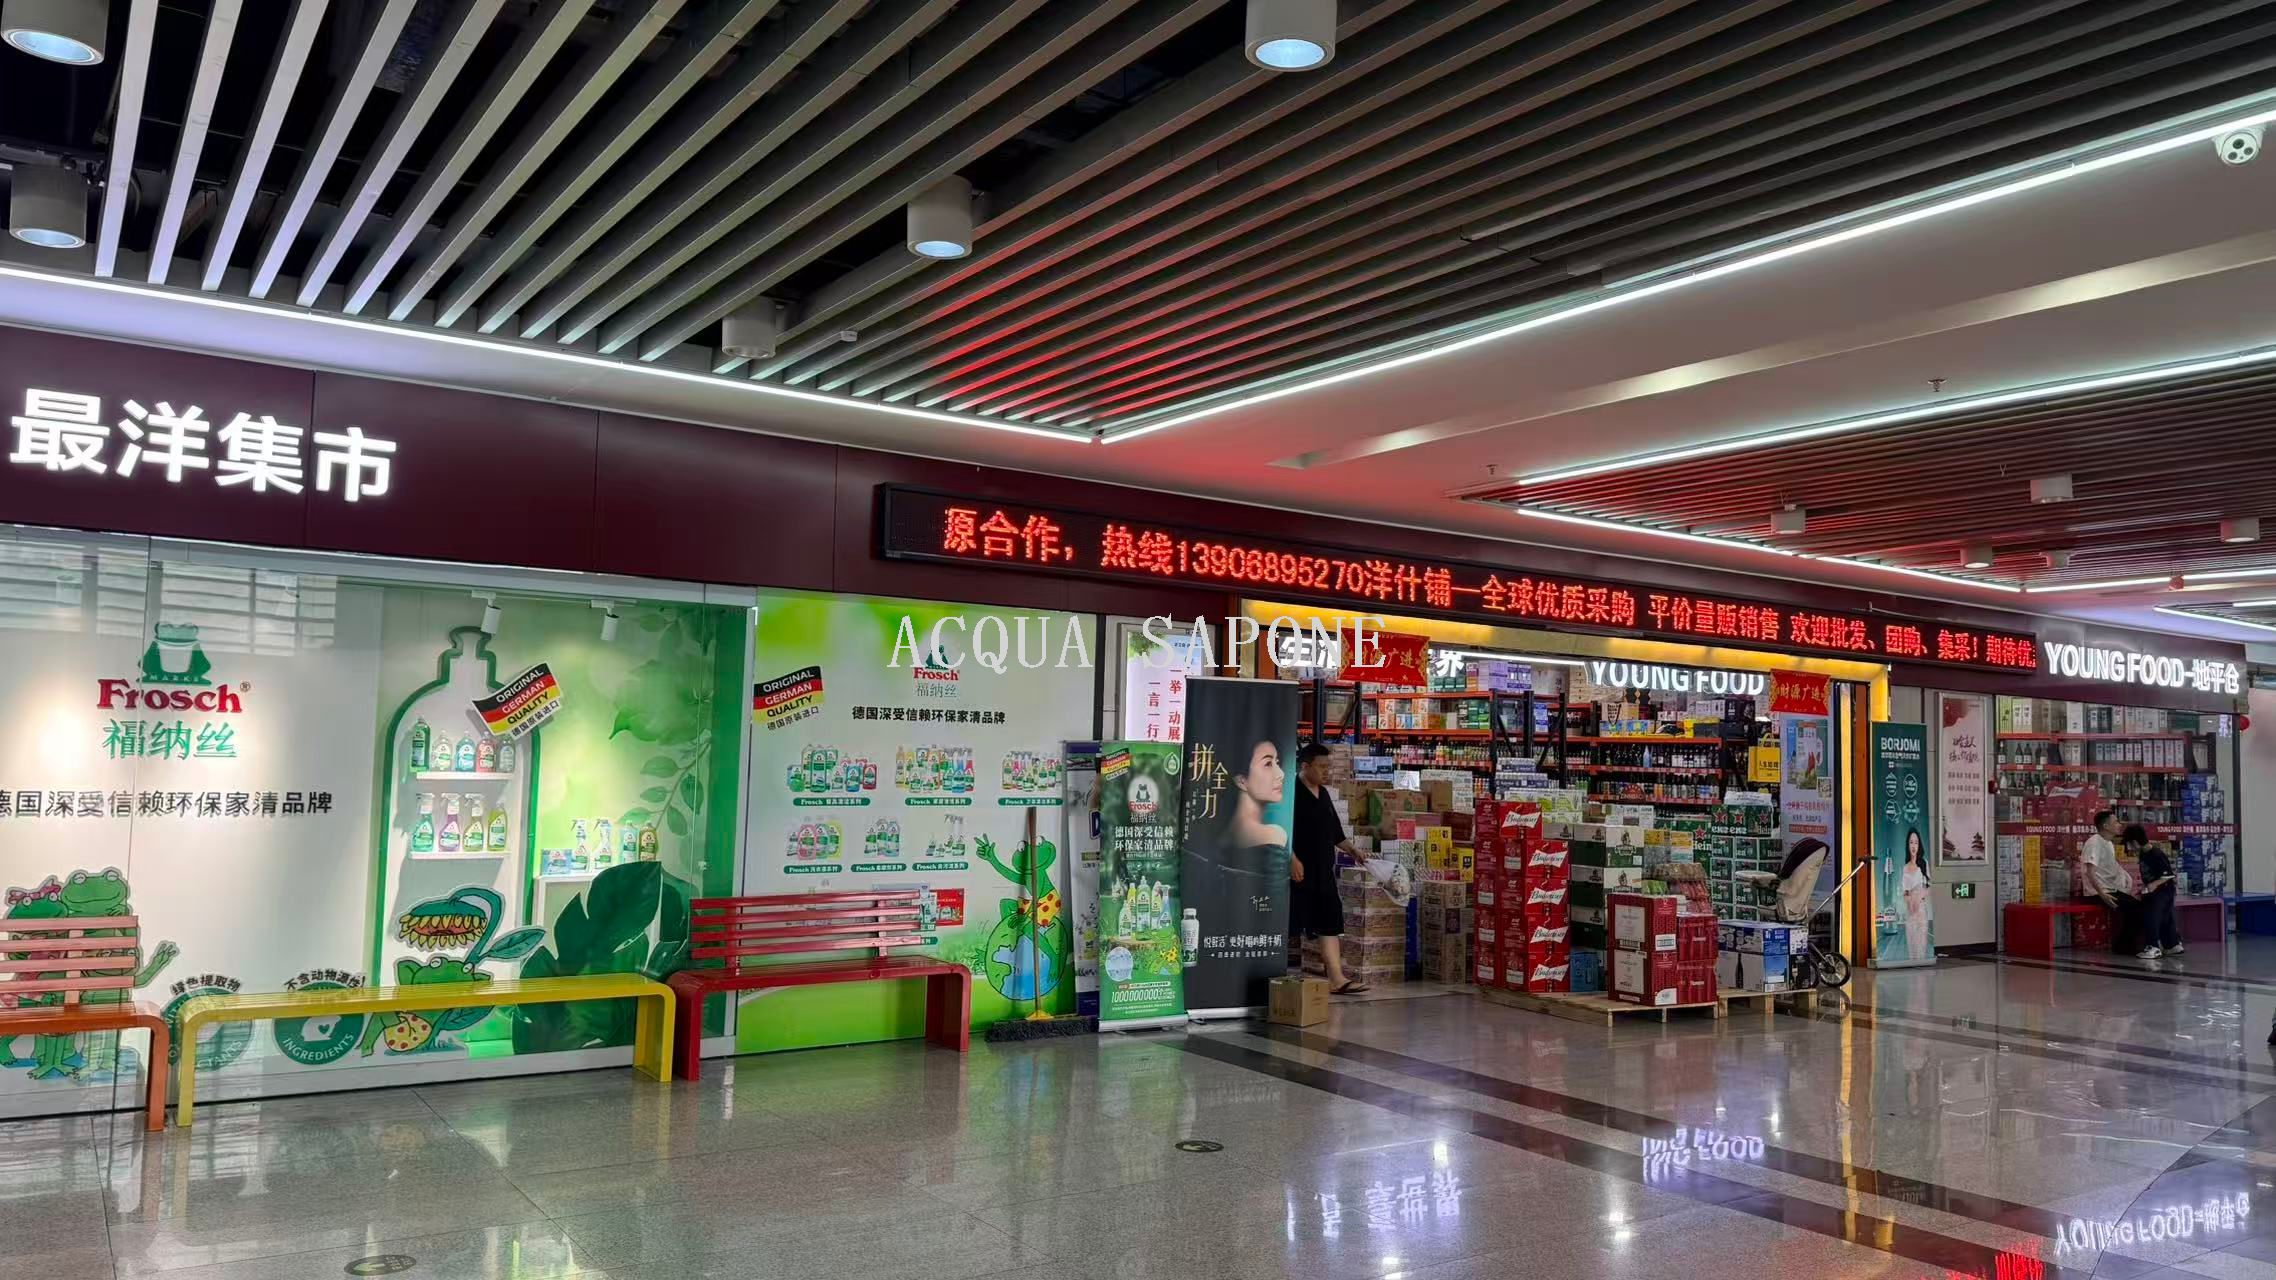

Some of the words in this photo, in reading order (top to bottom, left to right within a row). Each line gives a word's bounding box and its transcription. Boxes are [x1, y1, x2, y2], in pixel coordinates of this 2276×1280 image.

[10, 388, 397, 502] 最洋集市
[913, 667, 959, 681] Frosch
[2044, 642, 2125, 682] YOUNG
[496, 669, 544, 703] ORIGINAL
[763, 670, 815, 693] ORIGINAL
[915, 683, 957, 698] 福纳丝
[1591, 661, 1689, 692] YOUNG
[1695, 670, 1766, 696] FOOD
[97, 679, 243, 713] Frosch
[502, 681, 545, 714] GERMAN
[765, 682, 812, 705] GERMAN
[507, 691, 549, 724] QUALITY
[512, 699, 560, 736] 德国原装进口
[767, 695, 813, 717] QUALITY
[767, 706, 819, 730] 德国原装进口
[852, 706, 1006, 725] 德国深受信赖环保家清品牌
[102, 718, 237, 760] 福纳丝
[1881, 737, 1920, 752] BORJOMI
[1115, 826, 1174, 838] 德国深受信赖
[1115, 839, 1174, 851] 环保家清品牌
[171, 974, 241, 997] 绿色提取物
[282, 1033, 354, 1061] INGREDIENTS
